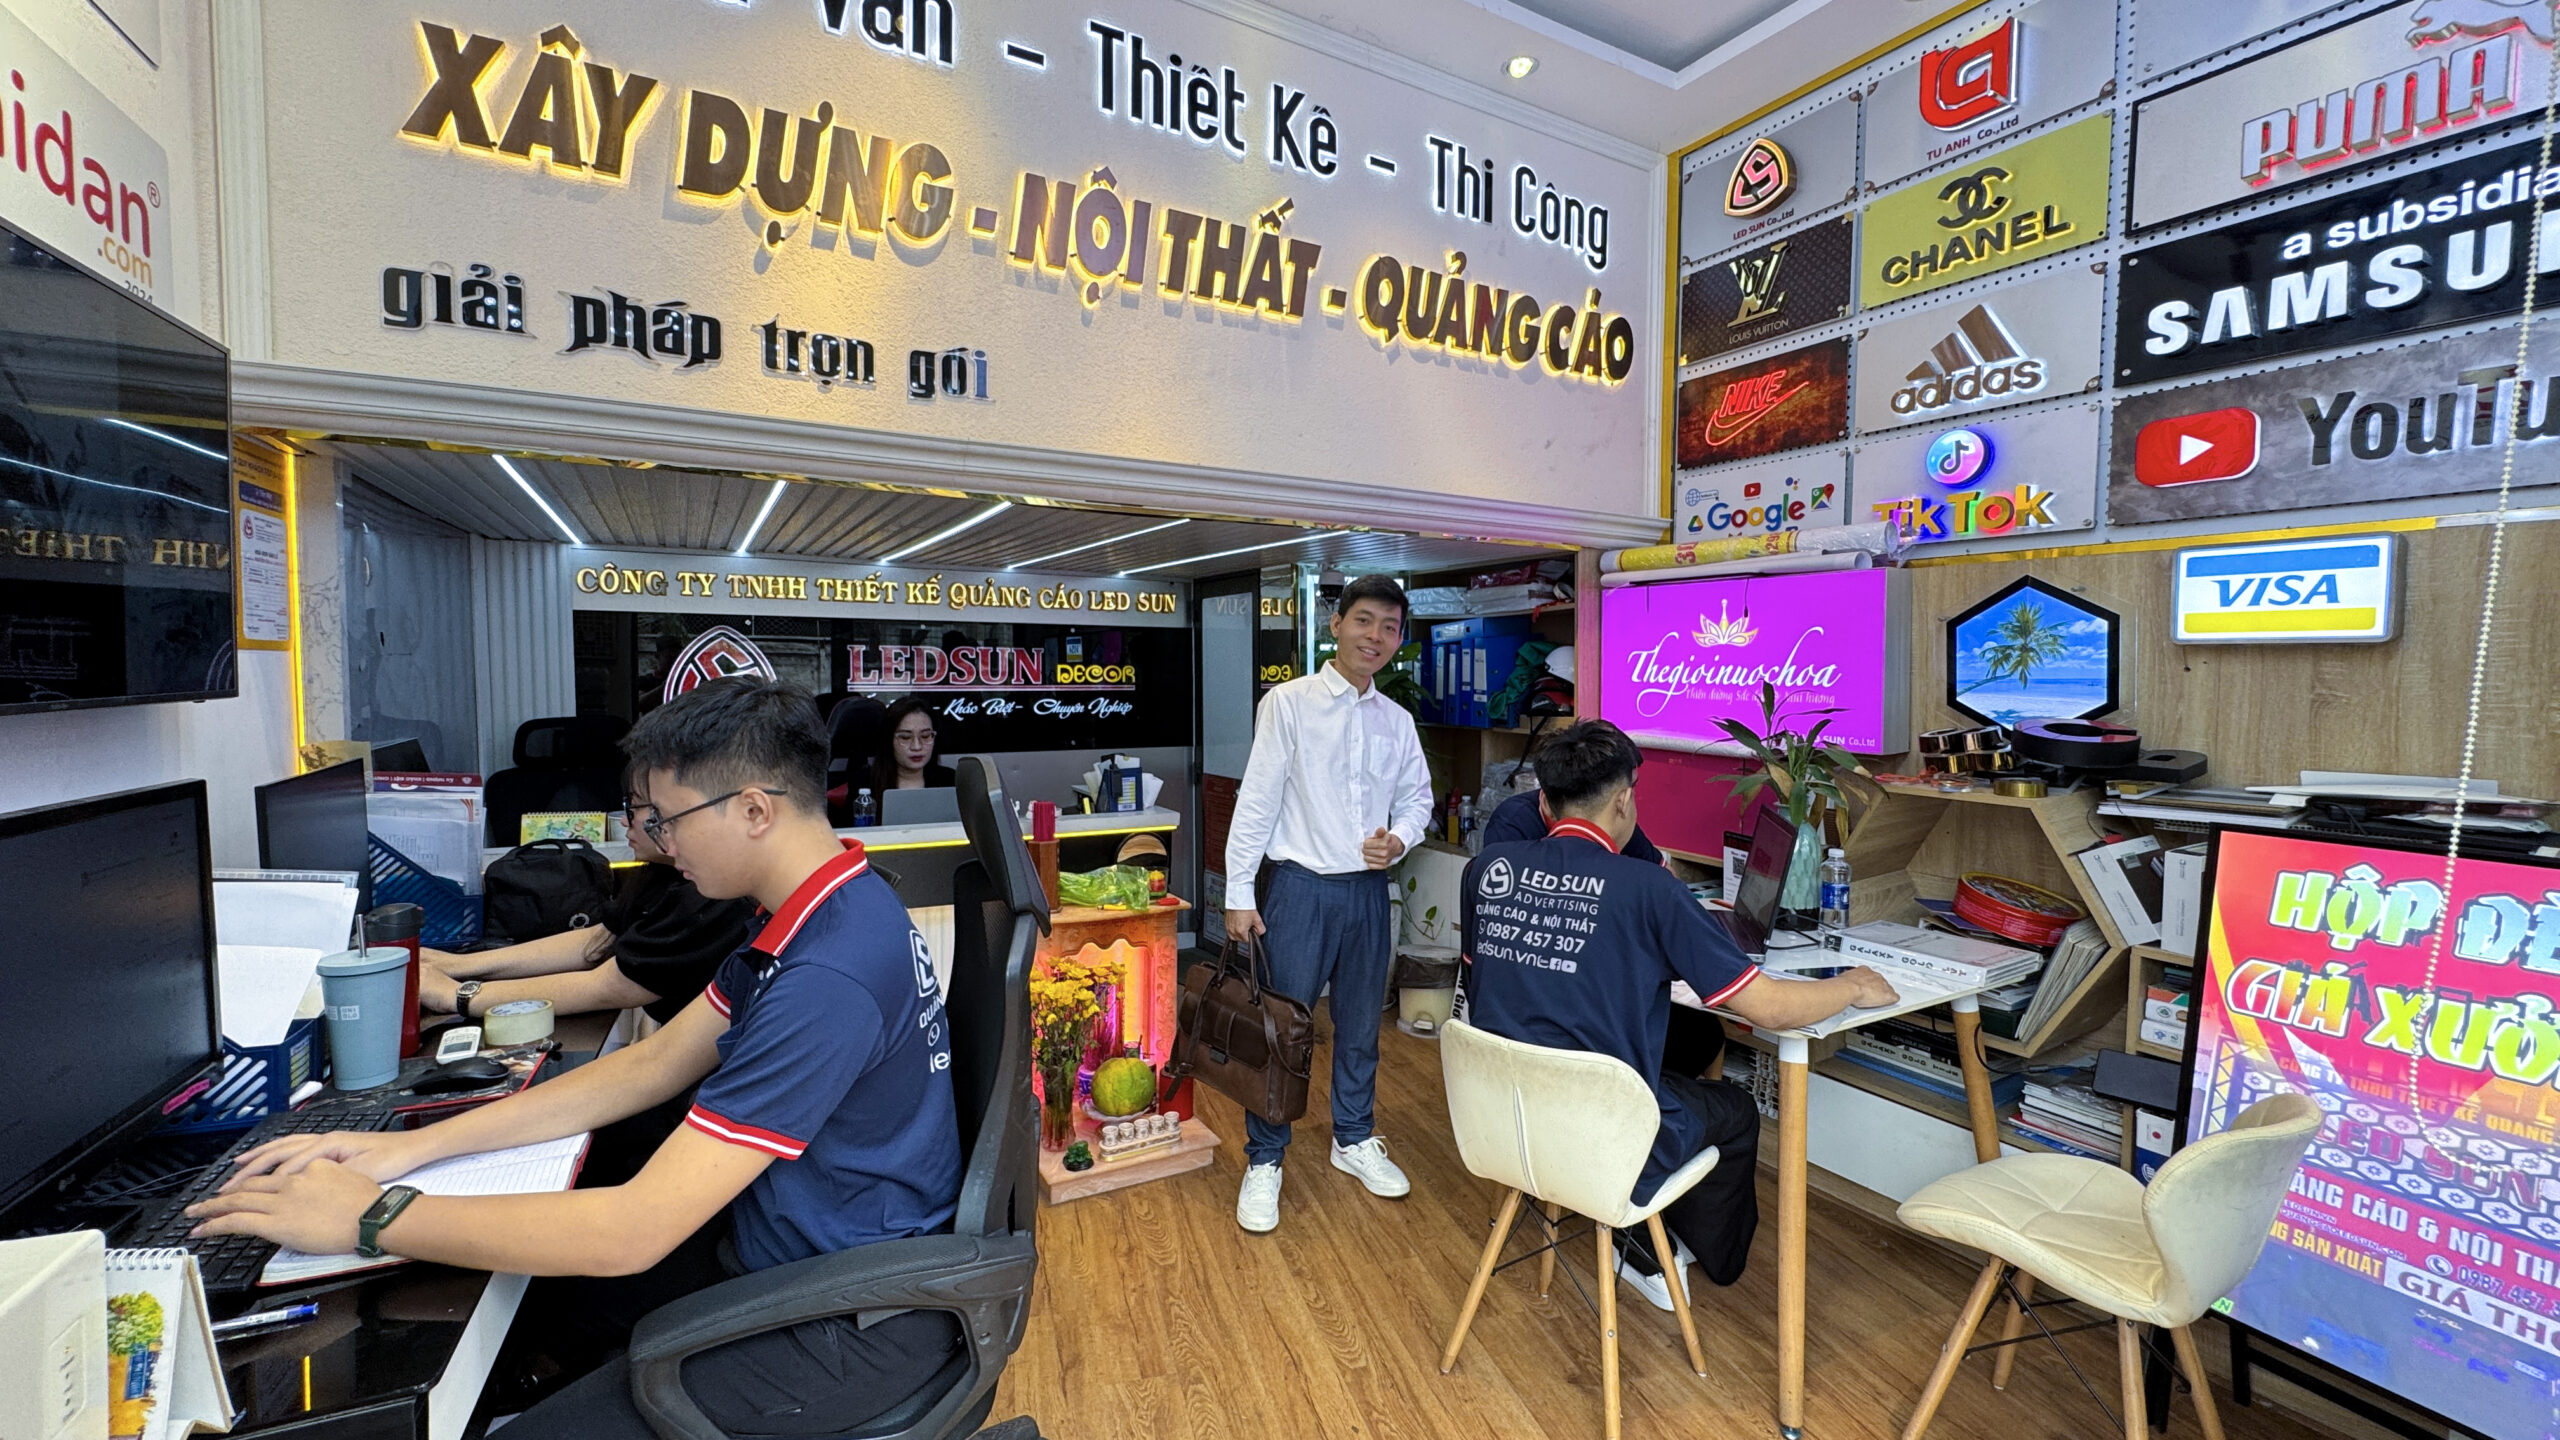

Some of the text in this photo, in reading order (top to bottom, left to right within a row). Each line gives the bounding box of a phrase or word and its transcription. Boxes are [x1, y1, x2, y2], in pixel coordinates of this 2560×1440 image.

[2241, 34, 2516, 187] PUMA
[1090, 20, 1247, 154] Thiết
[1273, 83, 1338, 177] Kế
[1428, 135, 1495, 225] Thi
[1513, 165, 1609, 270] Công
[1926, 115, 2019, 161] TU ANH Co.,Ltd
[400, 22, 660, 178] XÂY
[679, 89, 955, 246] DỰNG
[1010, 166, 1153, 307] NỘI
[1160, 198, 1322, 320] THẤT
[1733, 228, 1748, 241] LED
[1749, 221, 1766, 236] SUN
[1881, 205, 2073, 285] CHANEL
[2282, 231, 2312, 261] a
[98, 236, 153, 289] .com
[380, 262, 995, 401] giải pháp trọn gói
[1729, 318, 1790, 345] LOUIS VUITTON
[1719, 369, 1788, 419] NIKE
[1890, 358, 2045, 416] adidas
[1707, 493, 1806, 532] Google
[576, 562, 1177, 613] CÔNG TY TNHH THIẾT KẾ QUẢNG CÁO LED SUN
[2212, 574, 2340, 607] VISA
[847, 644, 1044, 686] LEDSUN
[1056, 664, 1136, 684] DECOR
[1627, 626, 1843, 717] Thegioinuochoa
[1033, 698, 1085, 719] Chuyên
[1088, 697, 1134, 719] Nghiệp
[1514, 892, 1599, 915] ADVERTISING
[1520, 867, 1605, 895] LED SUN
[1503, 905, 1527, 922] CÁO
[1530, 913, 1539, 925] &
[1543, 915, 1561, 930] NỘI
[1565, 917, 1597, 934] THẤT
[2269, 863, 2444, 951] HỘP
[1487, 921, 1586, 954] 0987 457 307
[1849, 944, 1894, 960] GALAXY
[1901, 956, 1934, 970] GOLD
[1861, 1039, 1896, 1055] GALAXY
[2226, 959, 2560, 1091] GIÁ XƯỞ
[930, 1050, 951, 1073] le
[2292, 1227, 2331, 1258] SẢN
[2334, 1245, 2383, 1279] XUẤT
[2352, 1193, 2408, 1233] CÁO
[2417, 1216, 2441, 1244] &
[2449, 1227, 2504, 1268] NỘI
[2398, 1271, 2473, 1317] GIÁ
